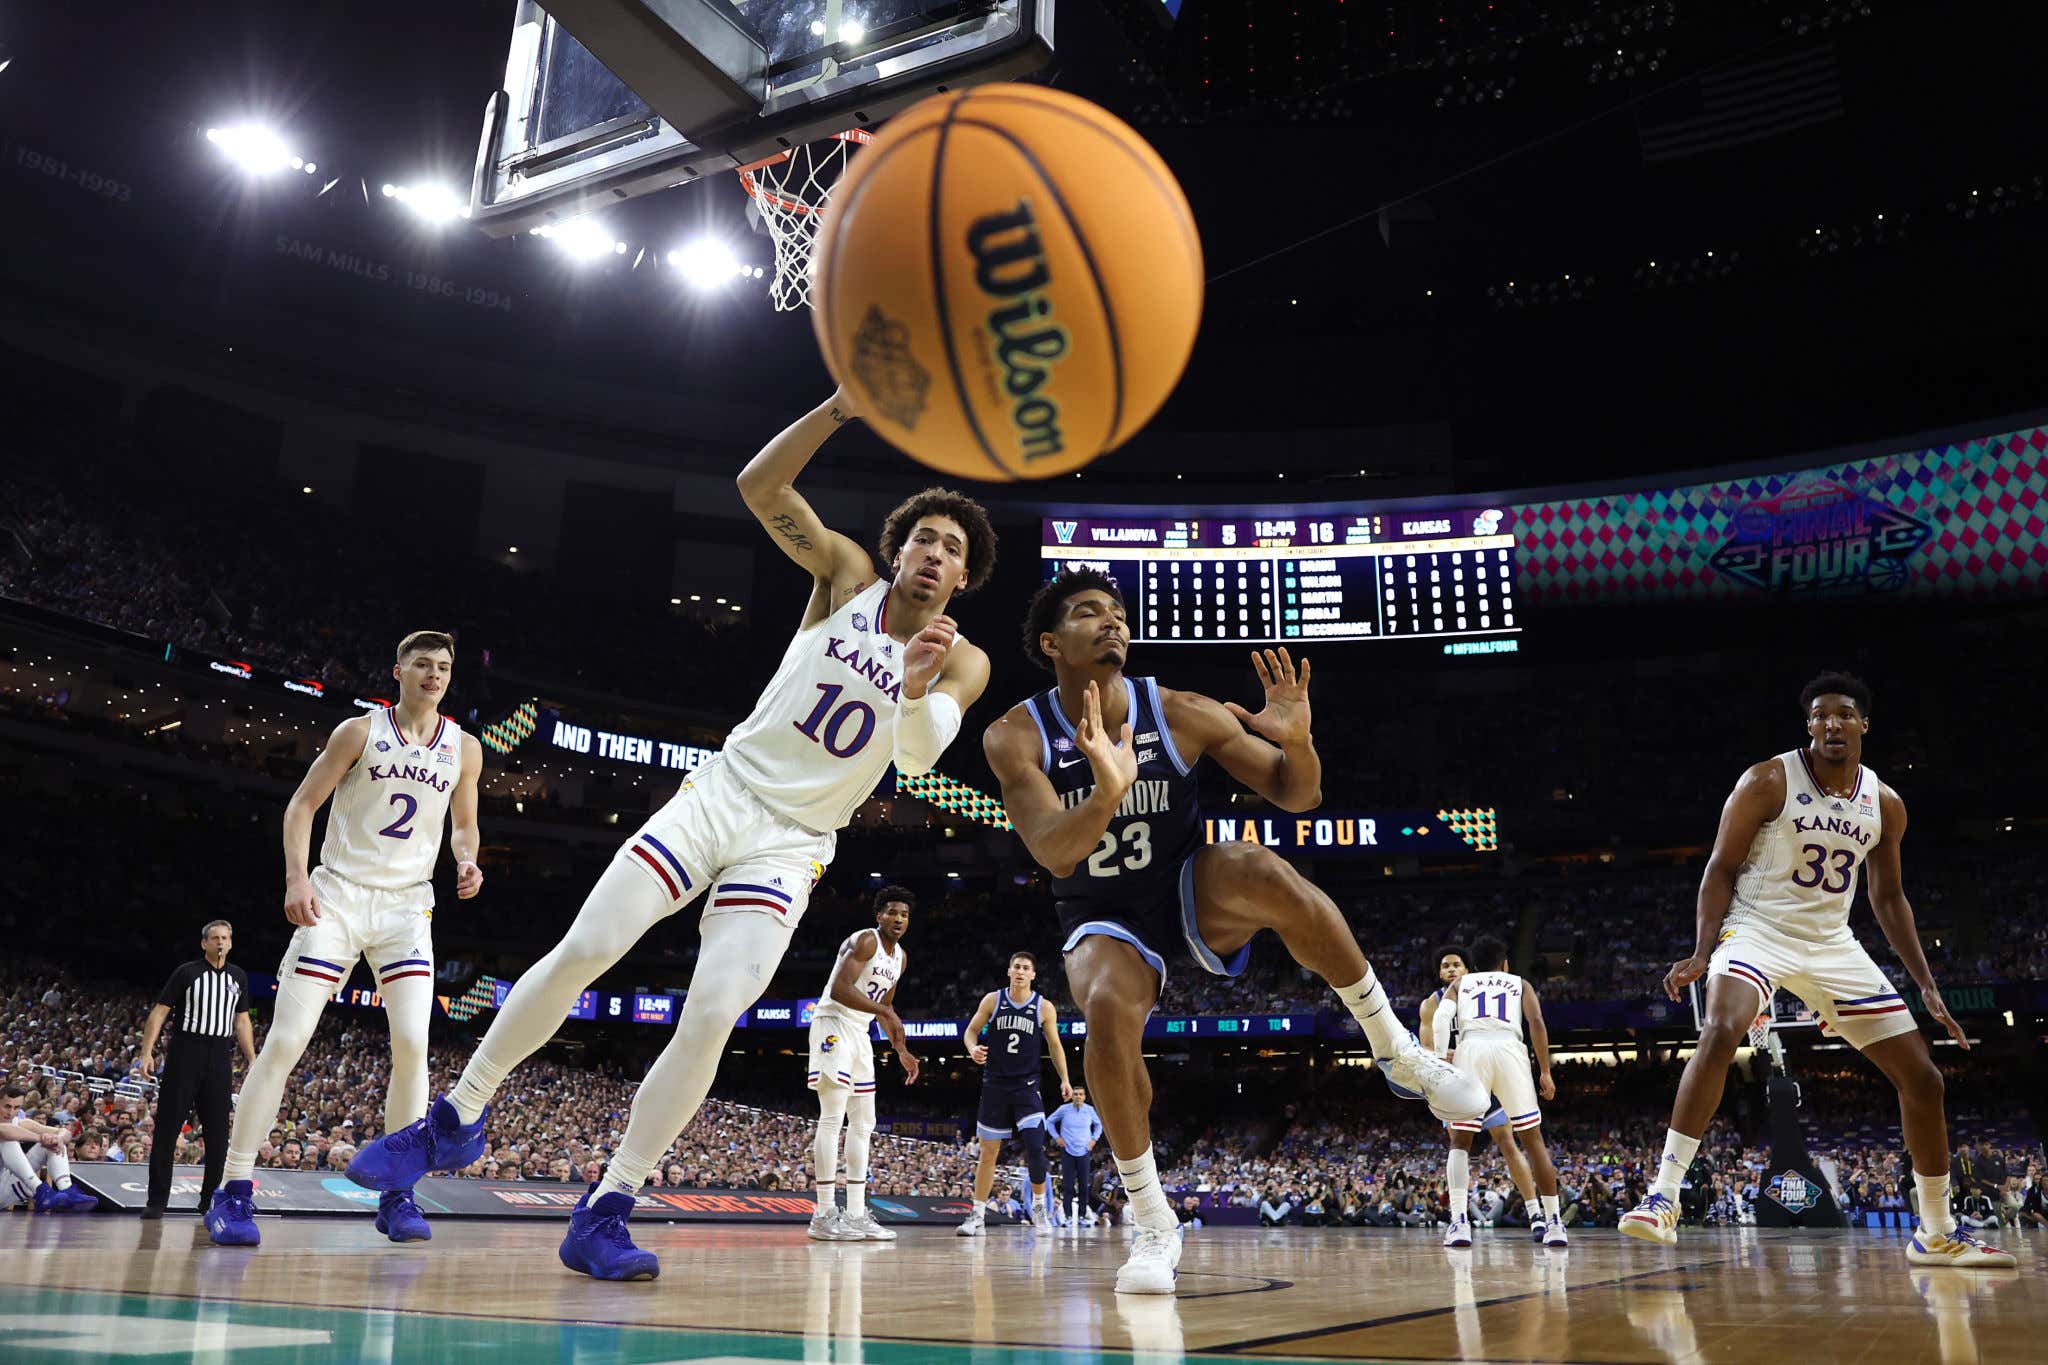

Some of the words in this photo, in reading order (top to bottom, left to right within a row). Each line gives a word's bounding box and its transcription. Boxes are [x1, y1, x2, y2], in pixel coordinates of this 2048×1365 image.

[17, 146, 133, 203] 1981-1993
[274, 234, 322, 265] SAM
[327, 248, 390, 282] MILLS
[406, 271, 514, 312] 1986-1994
[966, 196, 1072, 463] Wilson
[769, 513, 815, 554] FEAR
[1091, 527, 1158, 541] VILLANOVA
[1254, 520, 1296, 537] 12:44
[1308, 522, 1335, 543] 16
[1402, 519, 1451, 535] KANSAS
[1772, 502, 1872, 547] FINAL
[1222, 525, 1236, 545] 5
[1432, 554, 1437, 566] 1
[1771, 538, 1871, 585] FOUR
[1173, 578, 1178, 589] 1
[1411, 588, 1416, 599] 1
[1174, 594, 1178, 605] 1
[1196, 594, 1201, 605] 1
[1412, 604, 1417, 615] 1
[1174, 610, 1178, 621] 1
[1264, 625, 1270, 636] 1
[1286, 626, 1300, 636] 33
[1389, 621, 1396, 632] 7
[1413, 620, 1419, 631] 1
[1443, 640, 1519, 656] #MFINALFOUR
[825, 637, 902, 704] KANSA
[793, 682, 875, 759] 10
[552, 721, 592, 754] AND
[597, 731, 653, 765] THEN
[659, 742, 721, 771] THER
[368, 764, 450, 793] KANSAS
[379, 793, 418, 840] 2
[1205, 819, 1280, 846] INAL
[1296, 818, 1378, 846] FOUR
[1792, 816, 1871, 846] KANSAS
[1088, 822, 1152, 877] 23
[1792, 843, 1856, 894] 33
[351, 988, 386, 1008] FOU
[1475, 979, 1520, 997] MARTIN
[609, 997, 622, 1016] 5
[639, 997, 671, 1012] 12:44
[1471, 991, 1511, 1023] 11
[1951, 987, 1997, 1010] OUR
[757, 1008, 791, 1020] KANSAS
[996, 1014, 1035, 1036] VILLANOVA
[1166, 1020, 1186, 1033] AST
[1191, 1020, 1197, 1033] 1
[1242, 1019, 1249, 1032] 7
[1007, 1033, 1019, 1054] 2
[1781, 1180, 1807, 1190] FINAL
[650, 1193, 763, 1214] WERE
[1780, 1190, 1807, 1202] FOUR
